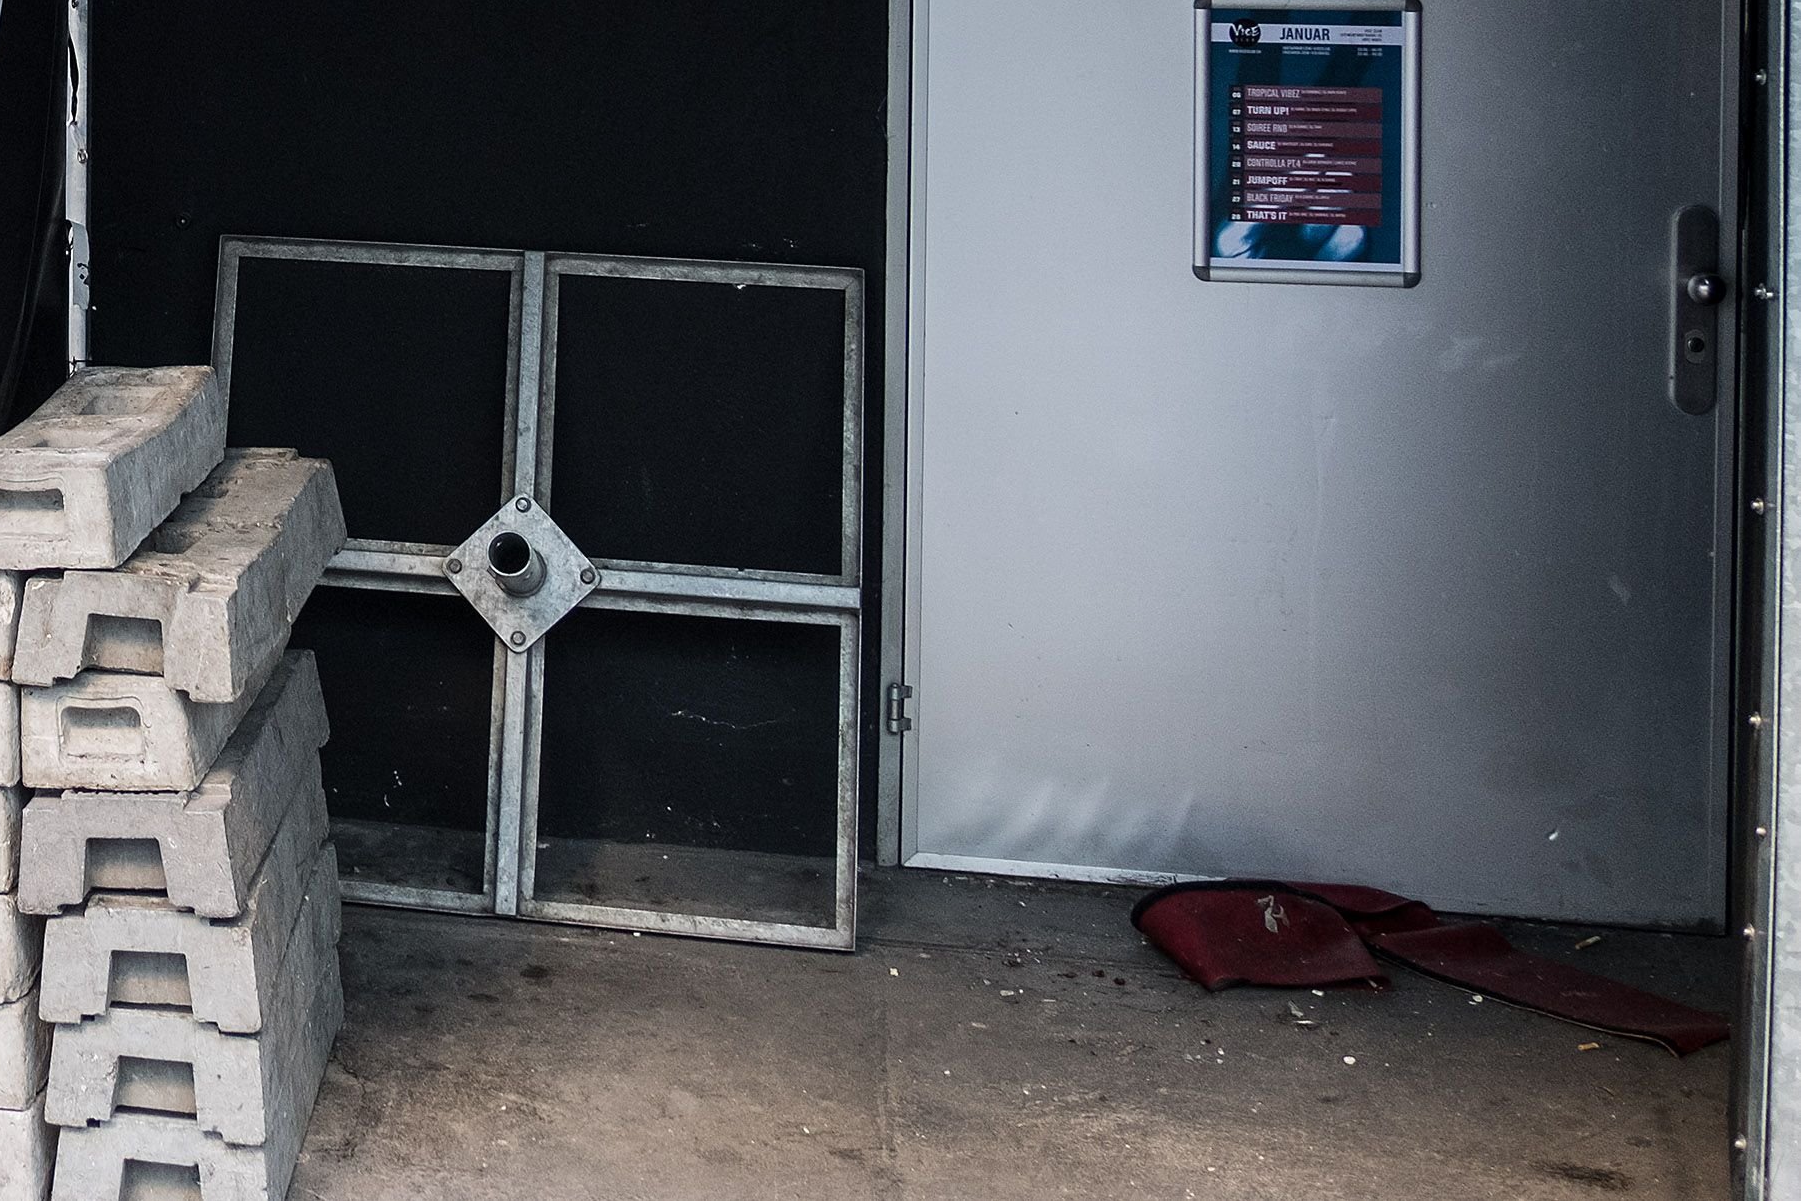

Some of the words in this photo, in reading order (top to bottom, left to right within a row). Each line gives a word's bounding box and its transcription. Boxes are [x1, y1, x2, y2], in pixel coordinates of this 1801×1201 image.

[1279, 28, 1330, 41] JANUAR
[1247, 88, 1279, 98] TROPICAL
[1247, 106, 1272, 115] TURN
[1273, 106, 1290, 116] UP!
[1247, 140, 1276, 150] SAUCE
[1247, 158, 1286, 168] CONTROLLA
[1246, 176, 1288, 185] JUMPOFF
[1247, 193, 1269, 202] BLACK
[1269, 193, 1294, 203] FRIDAY
[1247, 210, 1278, 220] THAT'S
[1278, 211, 1288, 220] IT
